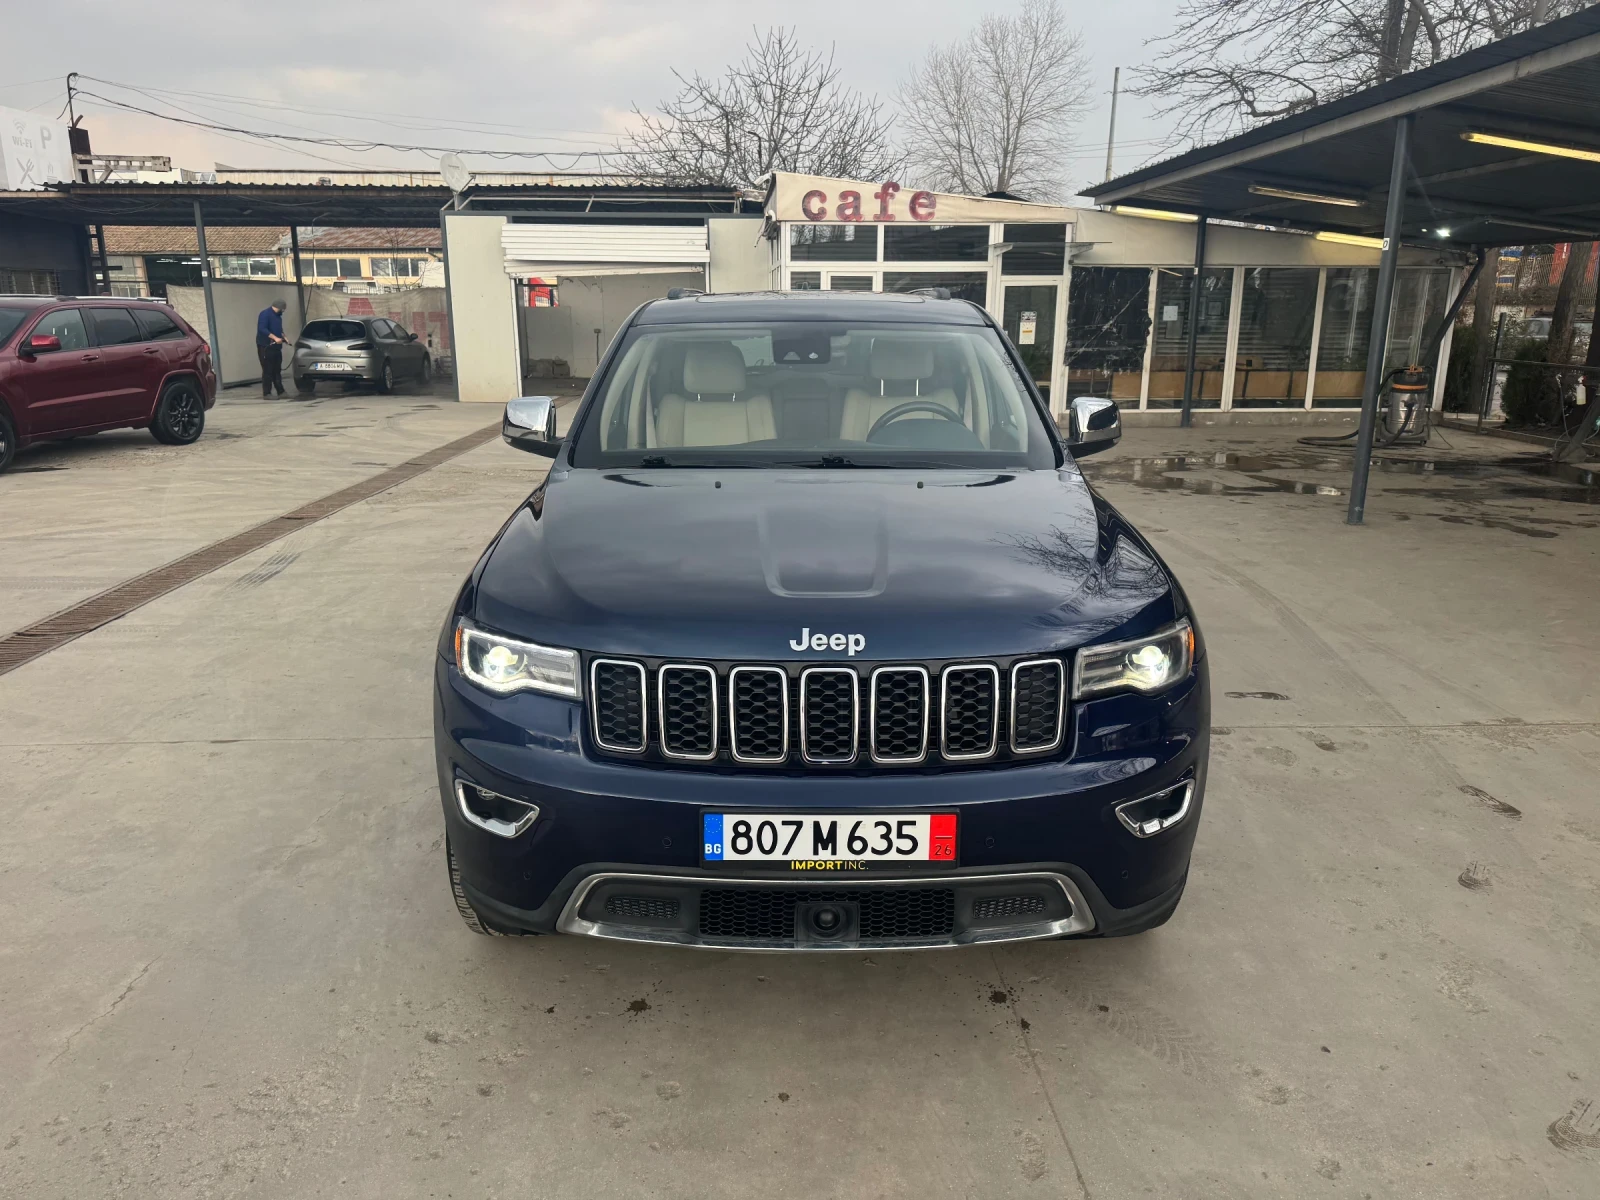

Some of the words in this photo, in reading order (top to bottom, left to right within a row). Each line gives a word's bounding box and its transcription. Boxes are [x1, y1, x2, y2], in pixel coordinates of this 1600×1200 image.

[801, 181, 937, 222] cafe
[789, 627, 866, 656] Jeep
[704, 843, 722, 855] BG
[731, 820, 804, 856] 807
[812, 820, 838, 856] M
[847, 820, 919, 856] 635
